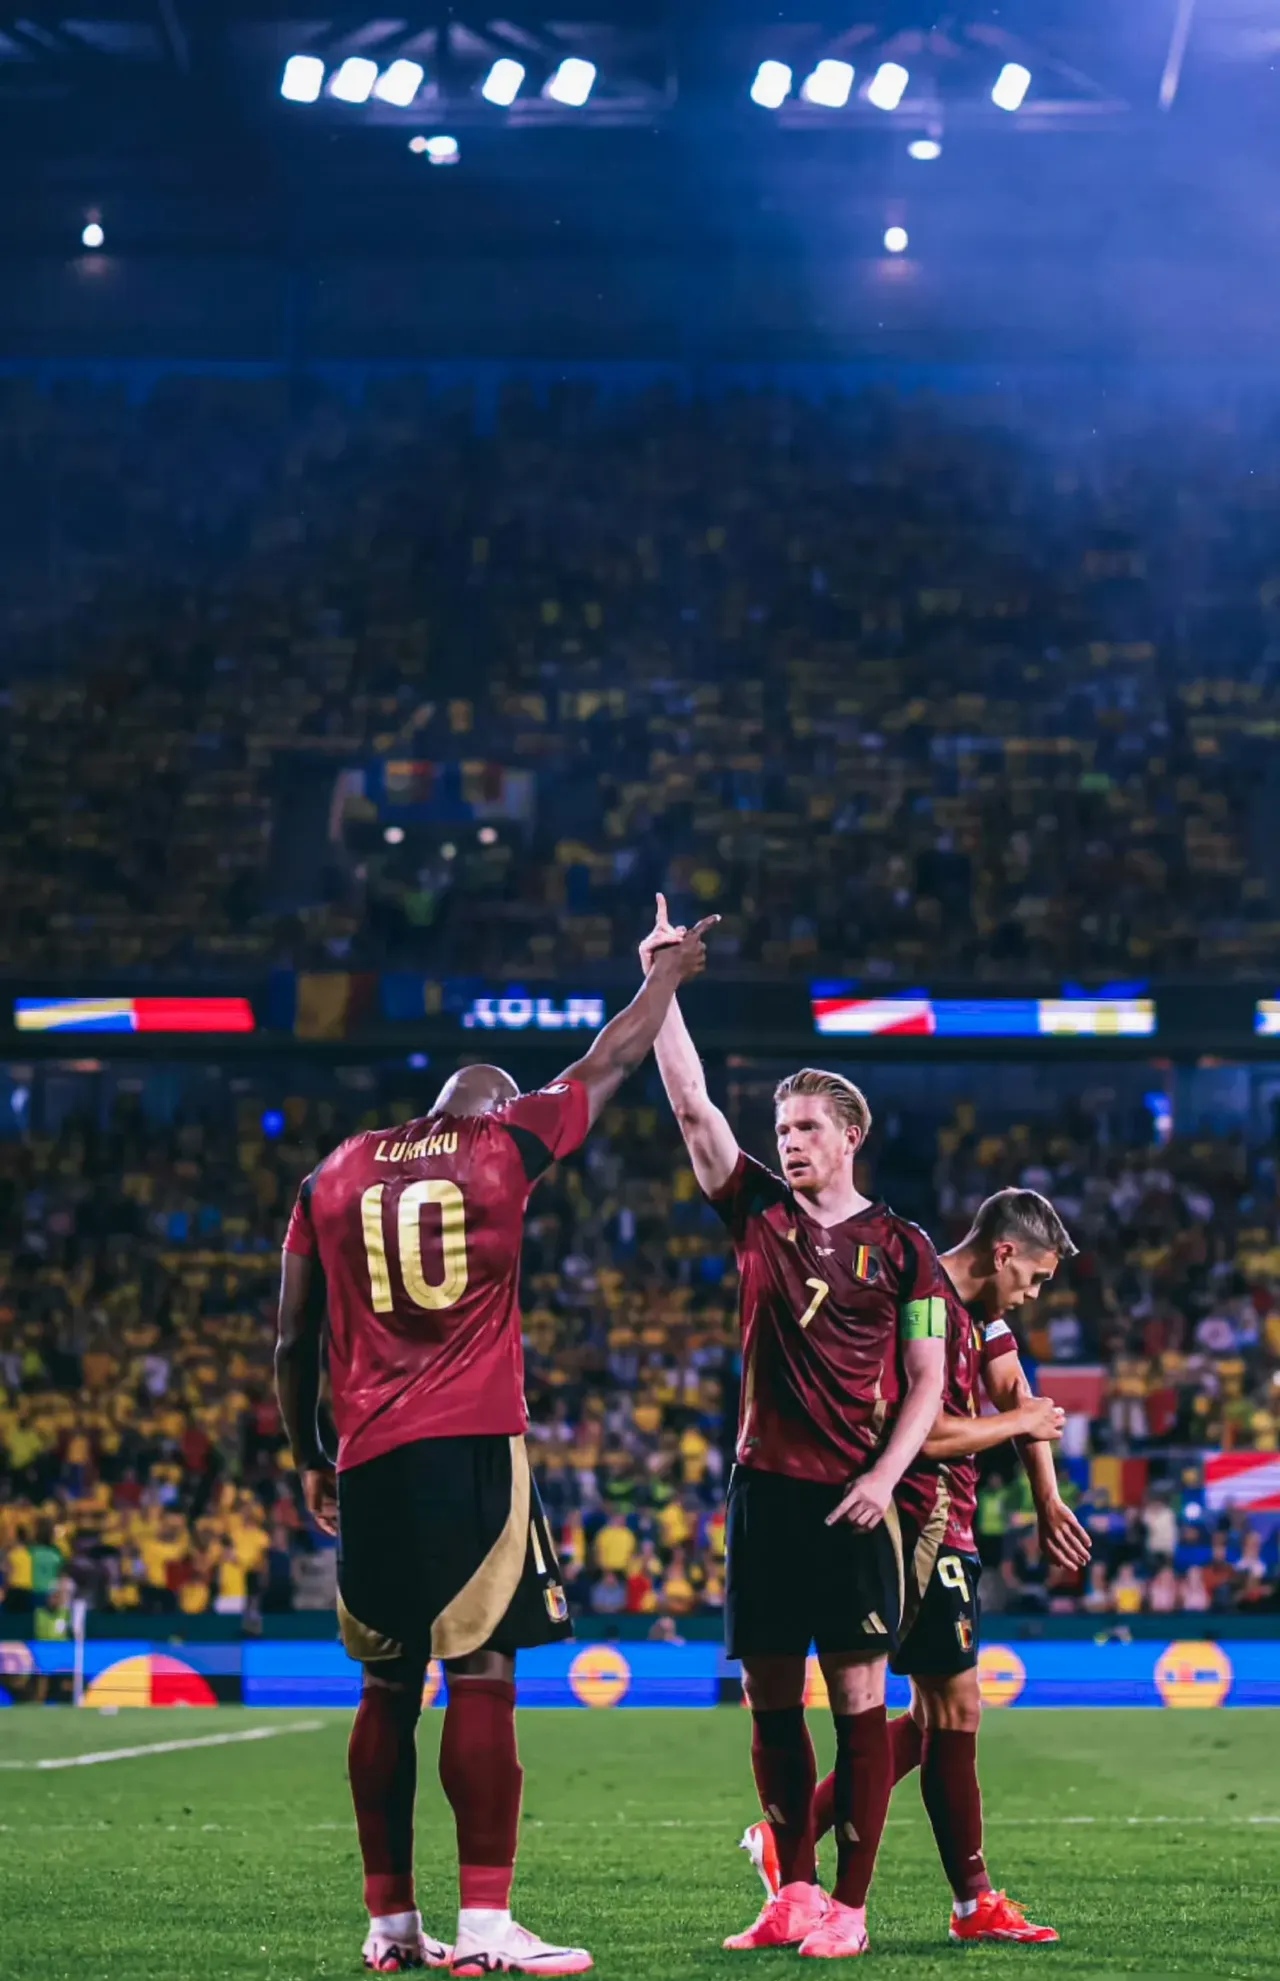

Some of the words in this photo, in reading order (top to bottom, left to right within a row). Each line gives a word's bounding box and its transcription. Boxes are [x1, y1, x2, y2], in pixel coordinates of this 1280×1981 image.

[374, 1132, 458, 1162] LUKAKU
[361, 1180, 468, 1313] 10
[800, 1278, 829, 1328] 7
[937, 1555, 970, 1602] 9
